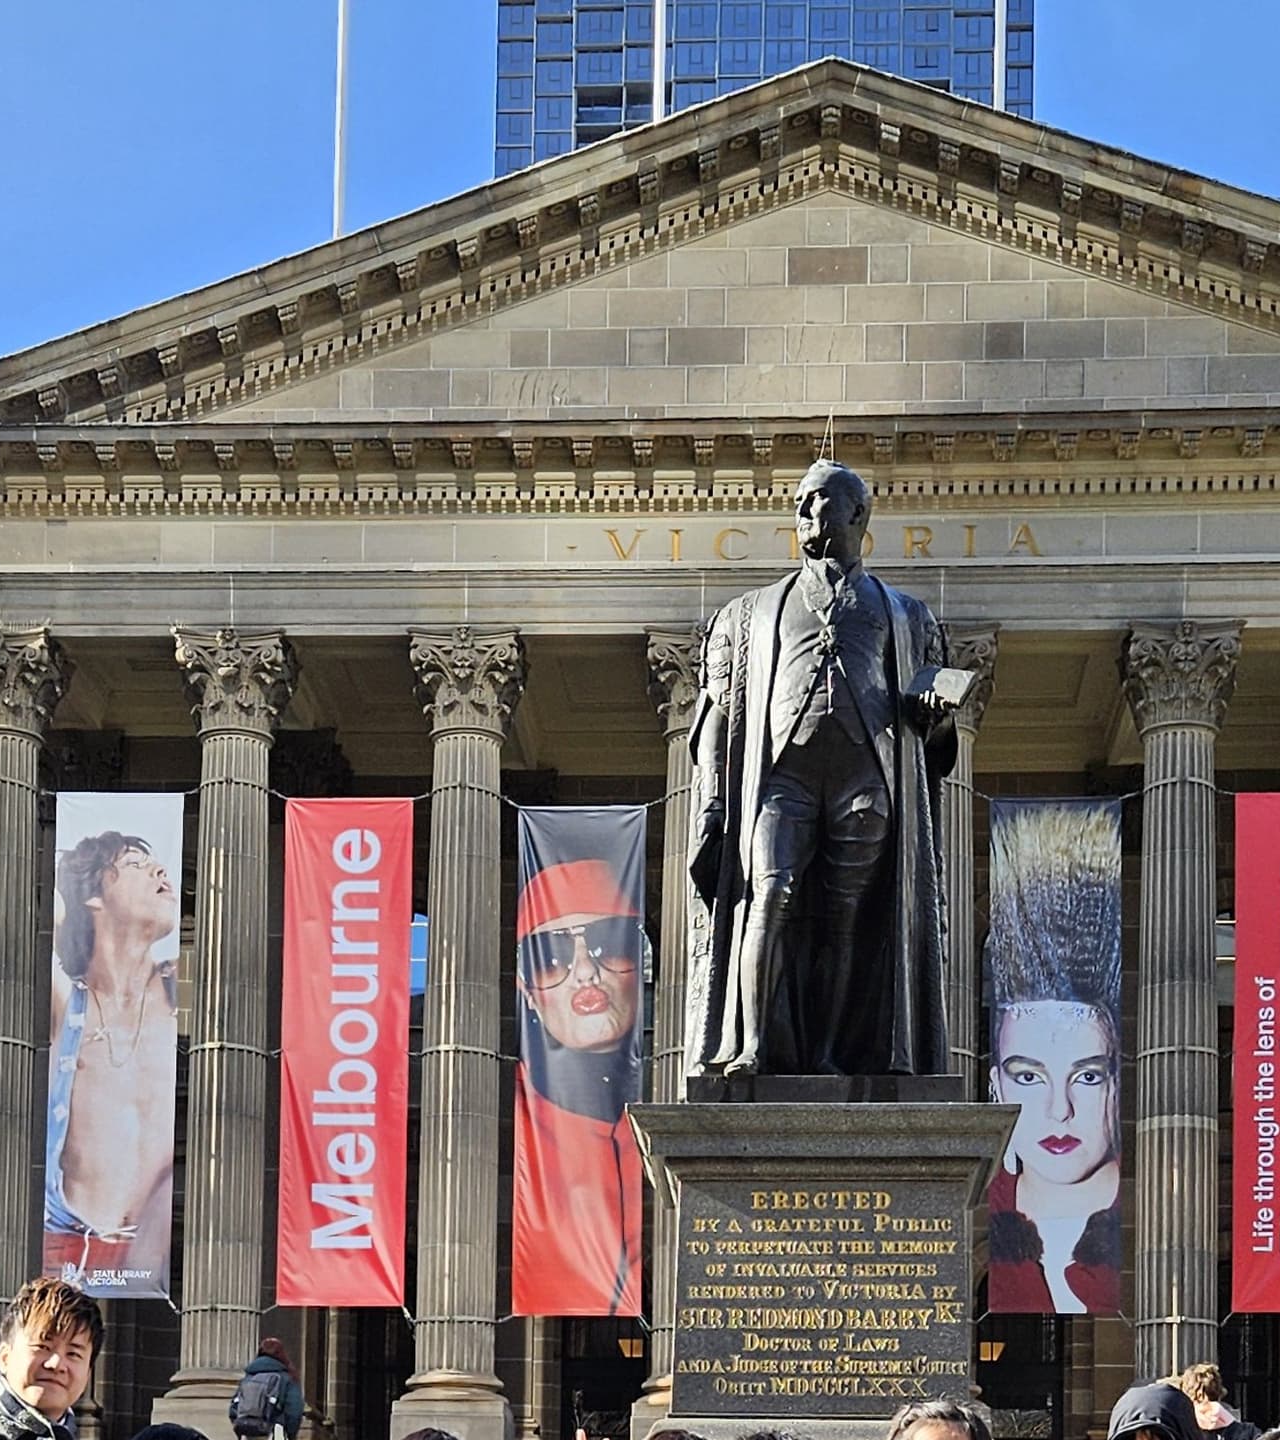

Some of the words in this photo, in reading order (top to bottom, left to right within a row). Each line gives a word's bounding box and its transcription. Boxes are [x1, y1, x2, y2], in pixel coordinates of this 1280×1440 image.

[603, 524, 1043, 562] VICTRIA
[1254, 977, 1275, 1001] of
[311, 828, 382, 1250] Melbourne
[1254, 1005, 1274, 1058] lens
[1253, 1062, 1274, 1103] the
[1253, 1104, 1280, 1201] through
[751, 1190, 891, 1210] ERECTED
[693, 1218, 720, 1233] BY
[726, 1218, 743, 1233] A
[751, 1218, 865, 1233] GRATEFUL
[1253, 1205, 1273, 1254] Life
[686, 1240, 710, 1255] TO
[714, 1240, 833, 1255] PERPETUATE
[837, 1240, 876, 1255] THE
[880, 1240, 958, 1255] MEMORY
[705, 1263, 727, 1277] OF
[732, 1263, 847, 1277] INVALUABLE
[852, 1263, 938, 1277] SERVICES
[688, 1284, 786, 1299] RENDERED
[791, 1285, 816, 1299] TO
[932, 1286, 958, 1299] BY
[678, 1307, 724, 1330] SIR
[726, 1306, 843, 1330] REDMOND
[845, 1307, 933, 1330] BARRY
[818, 1337, 840, 1352] OF
[799, 1360, 833, 1374] THE
